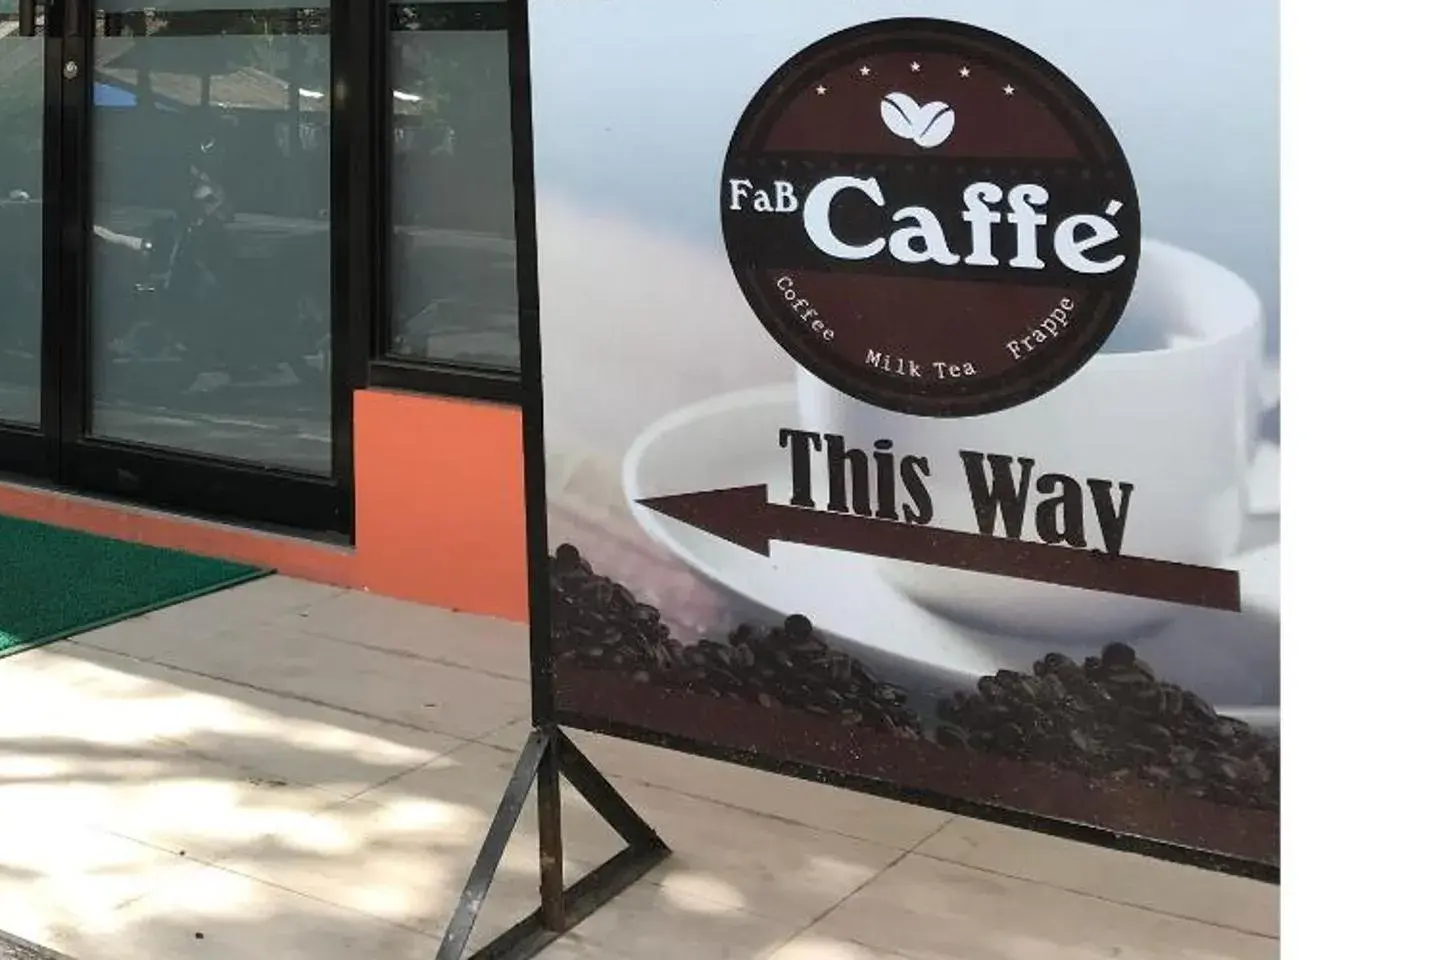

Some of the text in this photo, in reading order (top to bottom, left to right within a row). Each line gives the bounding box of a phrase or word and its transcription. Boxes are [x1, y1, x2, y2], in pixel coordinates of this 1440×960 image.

[729, 175, 1126, 275] FaB Caffé
[776, 275, 1075, 380] Coffee Milk Tea Frappe
[779, 427, 1135, 560] This Way
